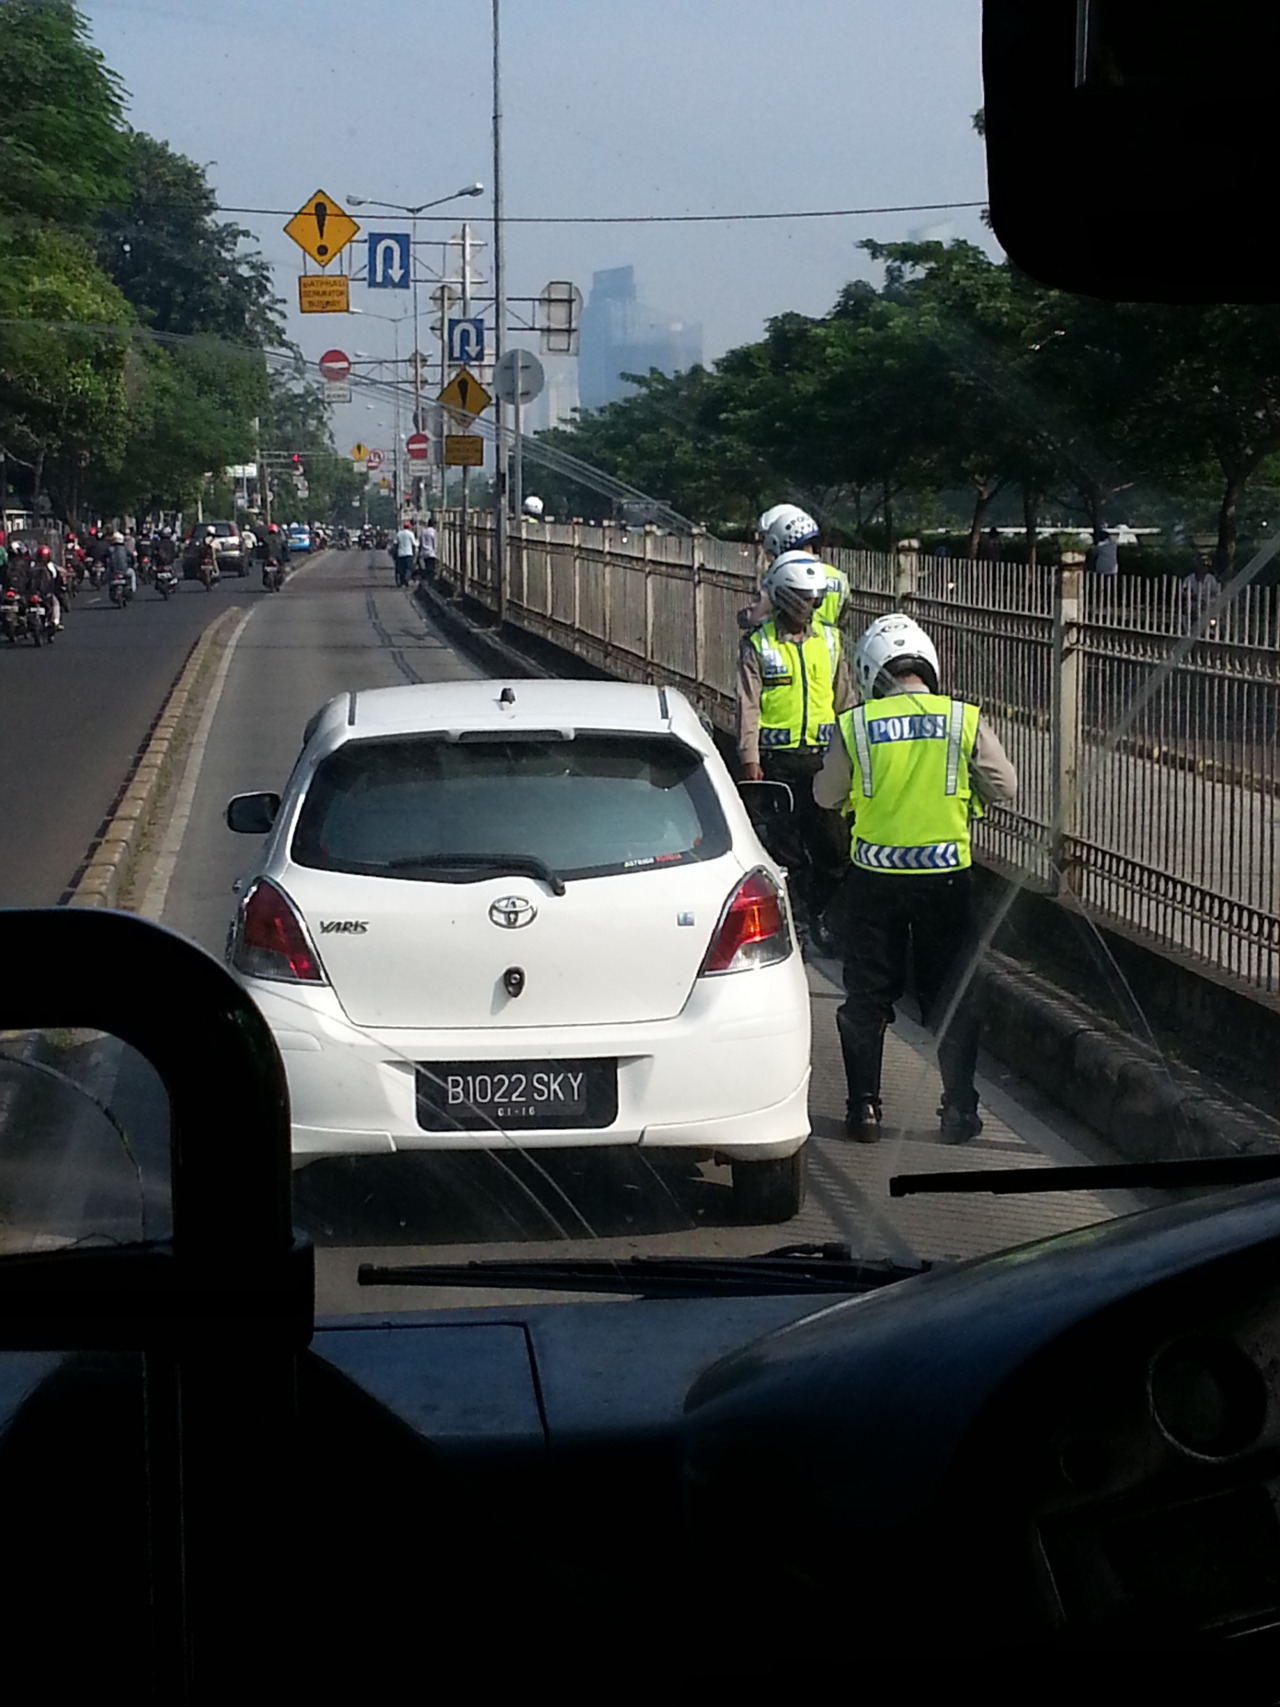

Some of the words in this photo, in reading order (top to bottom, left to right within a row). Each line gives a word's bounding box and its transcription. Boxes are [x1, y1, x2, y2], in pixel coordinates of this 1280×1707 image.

[872, 715, 945, 741] POLISI
[320, 920, 370, 934] YARIS
[533, 1072, 583, 1101] SKY
